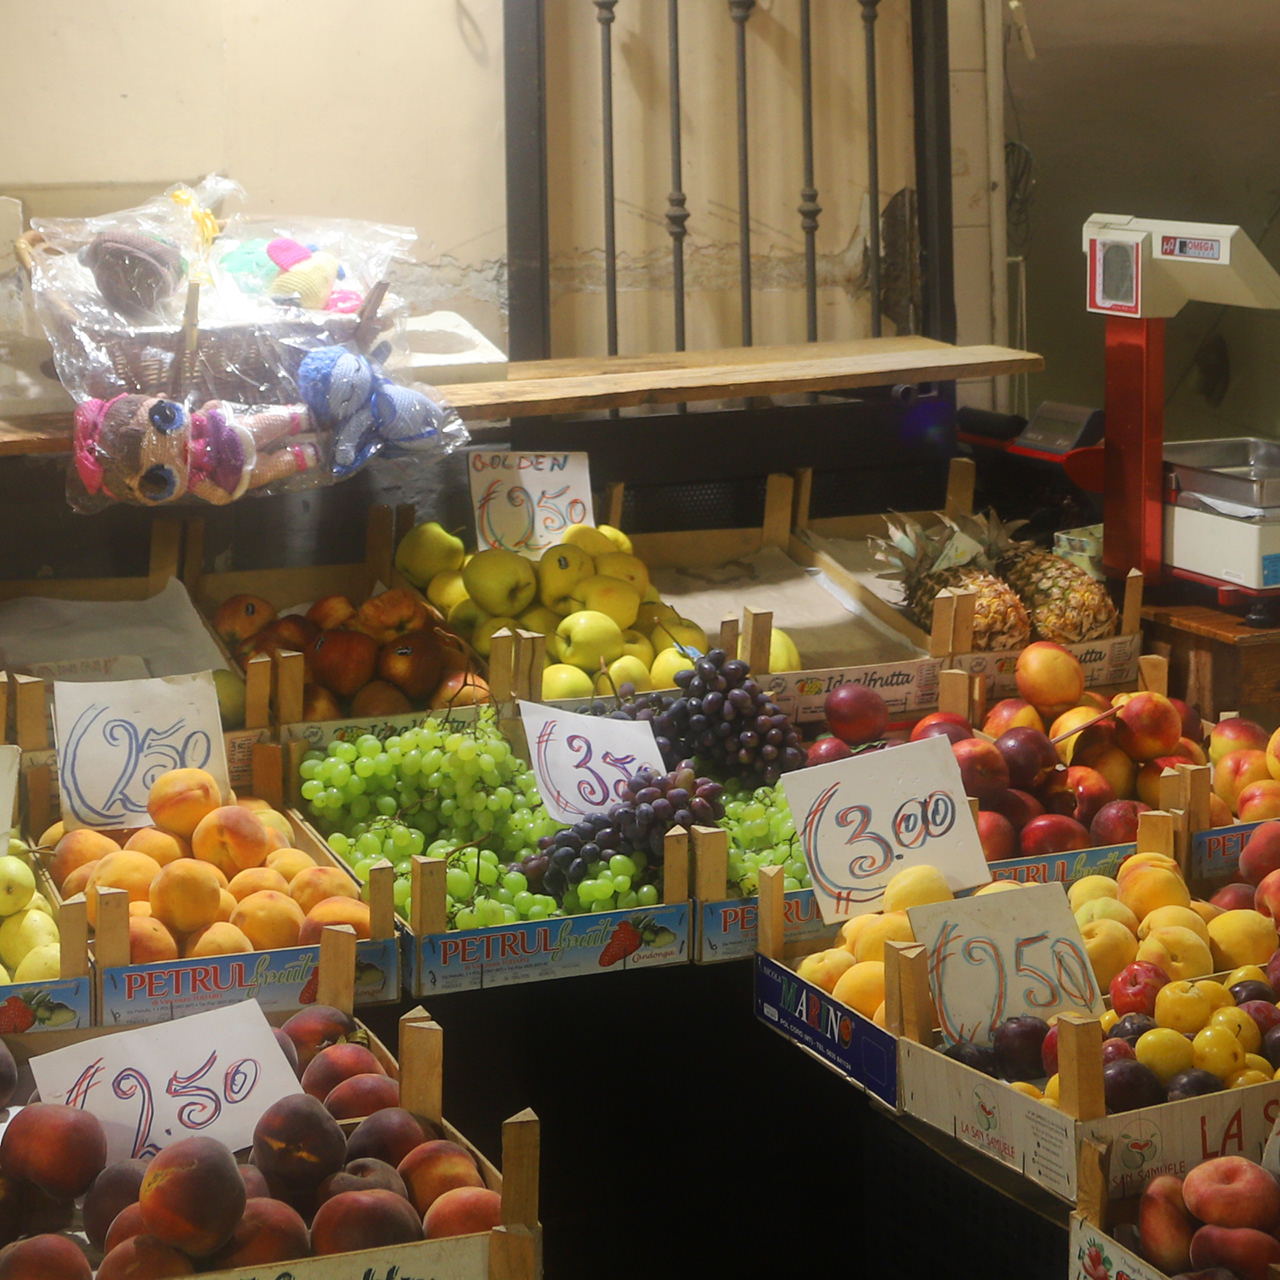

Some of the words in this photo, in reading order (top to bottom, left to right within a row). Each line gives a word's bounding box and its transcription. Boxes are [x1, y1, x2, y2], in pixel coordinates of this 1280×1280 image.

[1187, 240, 1215, 252] OMEGA
[473, 454, 569, 472] GOLDEN
[439, 926, 561, 967] PETRUL
[550, 919, 619, 962] fruit
[124, 962, 257, 1000] PETRUL
[245, 954, 320, 999] fruit
[779, 975, 853, 1050] MARINO
[986, 1130, 1016, 1159] SAMUELE
[1200, 1107, 1244, 1161] LA
